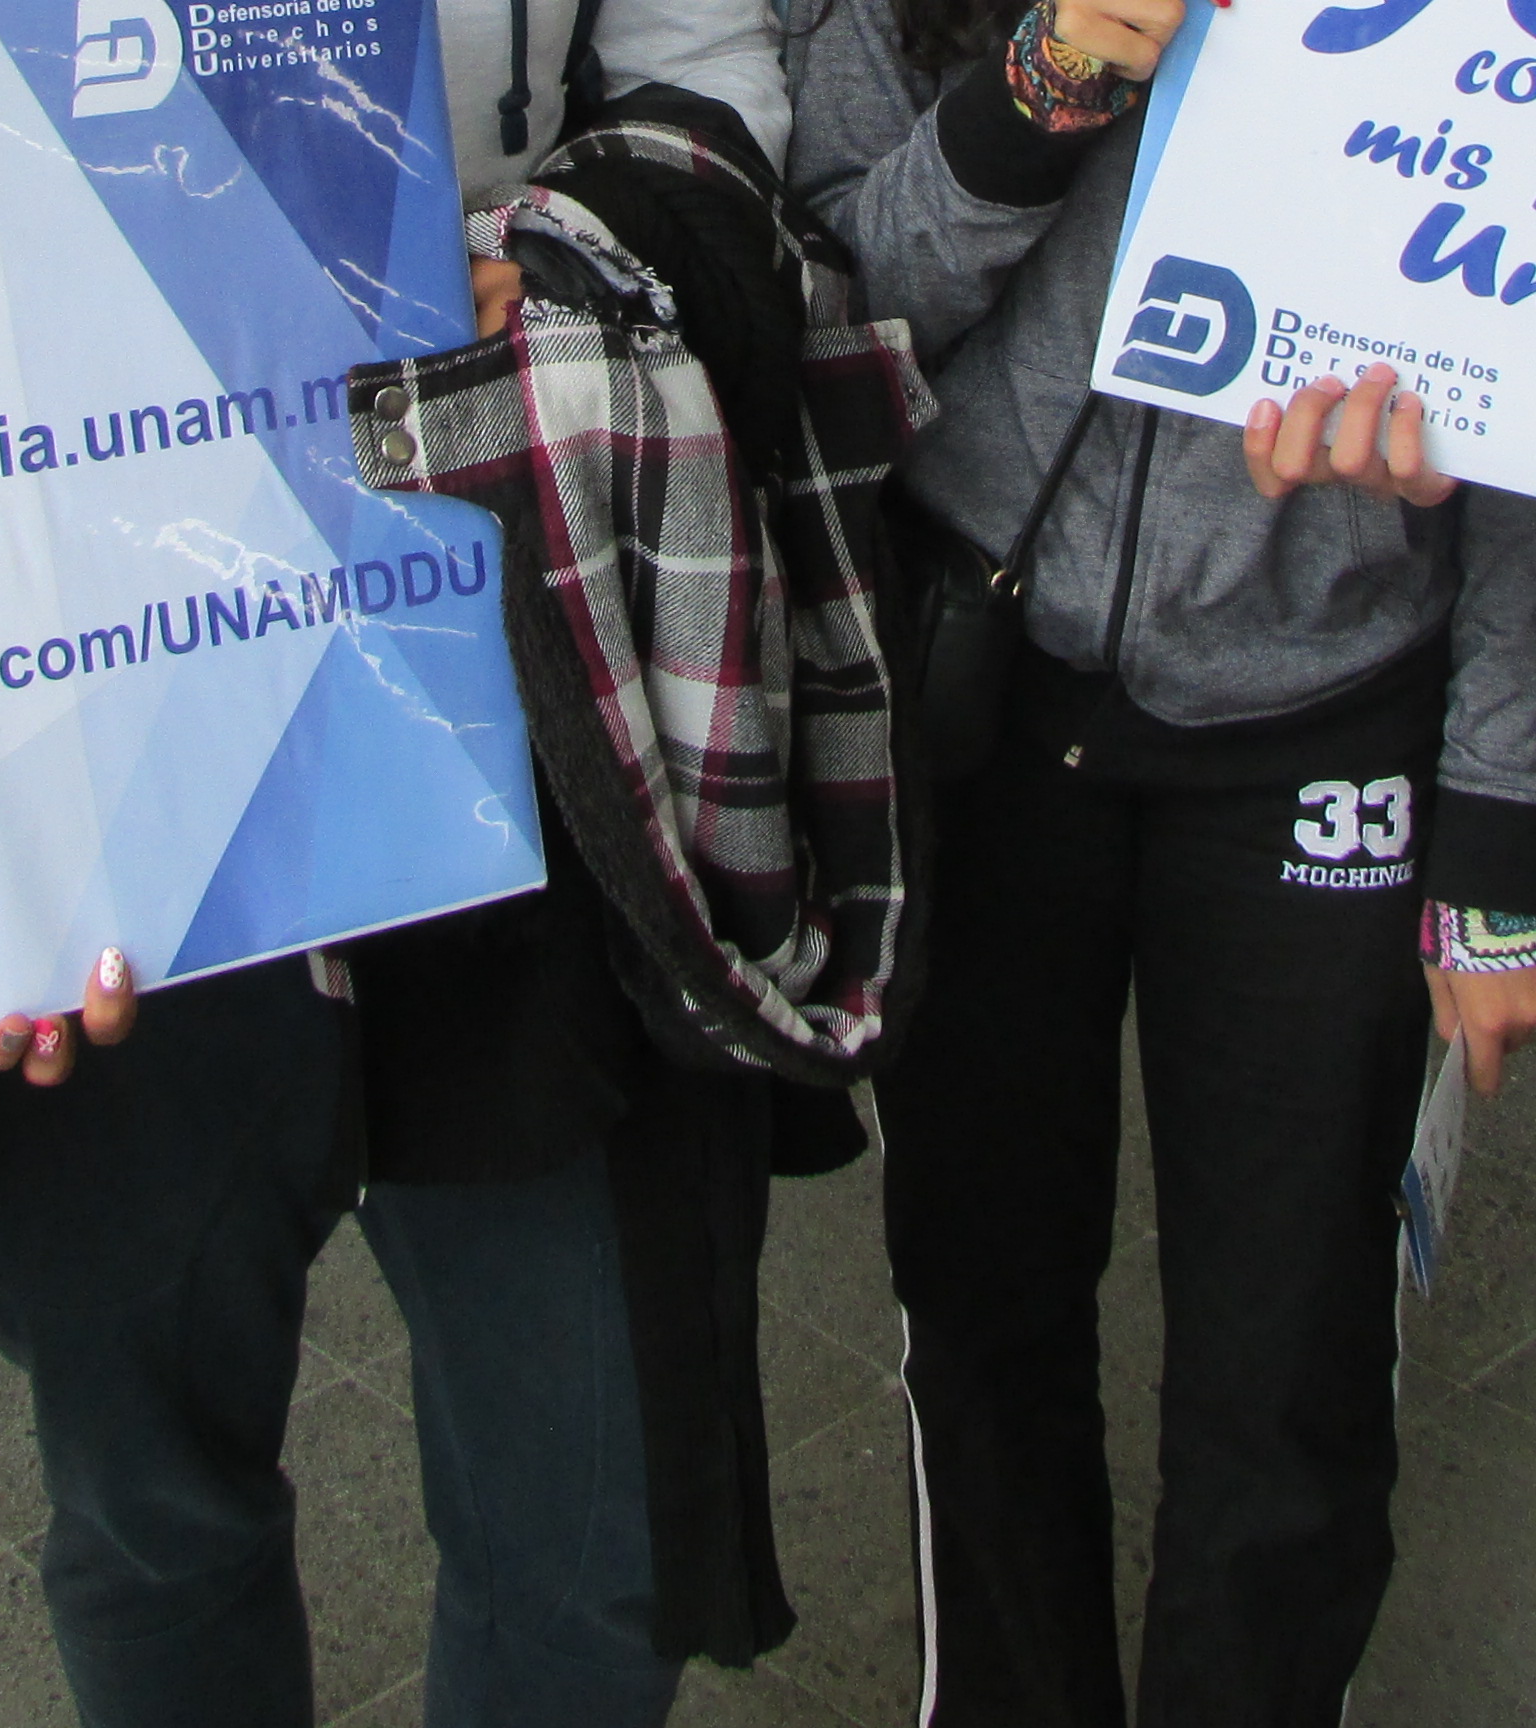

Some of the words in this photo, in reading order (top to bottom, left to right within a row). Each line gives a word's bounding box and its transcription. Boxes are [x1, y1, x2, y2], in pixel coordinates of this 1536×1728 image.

[191, 17, 379, 51] Derechos
[194, 40, 382, 76] Universitarios
[1344, 119, 1492, 189] mis
[1265, 334, 1492, 409] Derehos
[1271, 308, 1416, 363] Defensoría
[1425, 351, 1454, 372] de
[1462, 358, 1498, 383] los
[1294, 775, 1412, 860] 33
